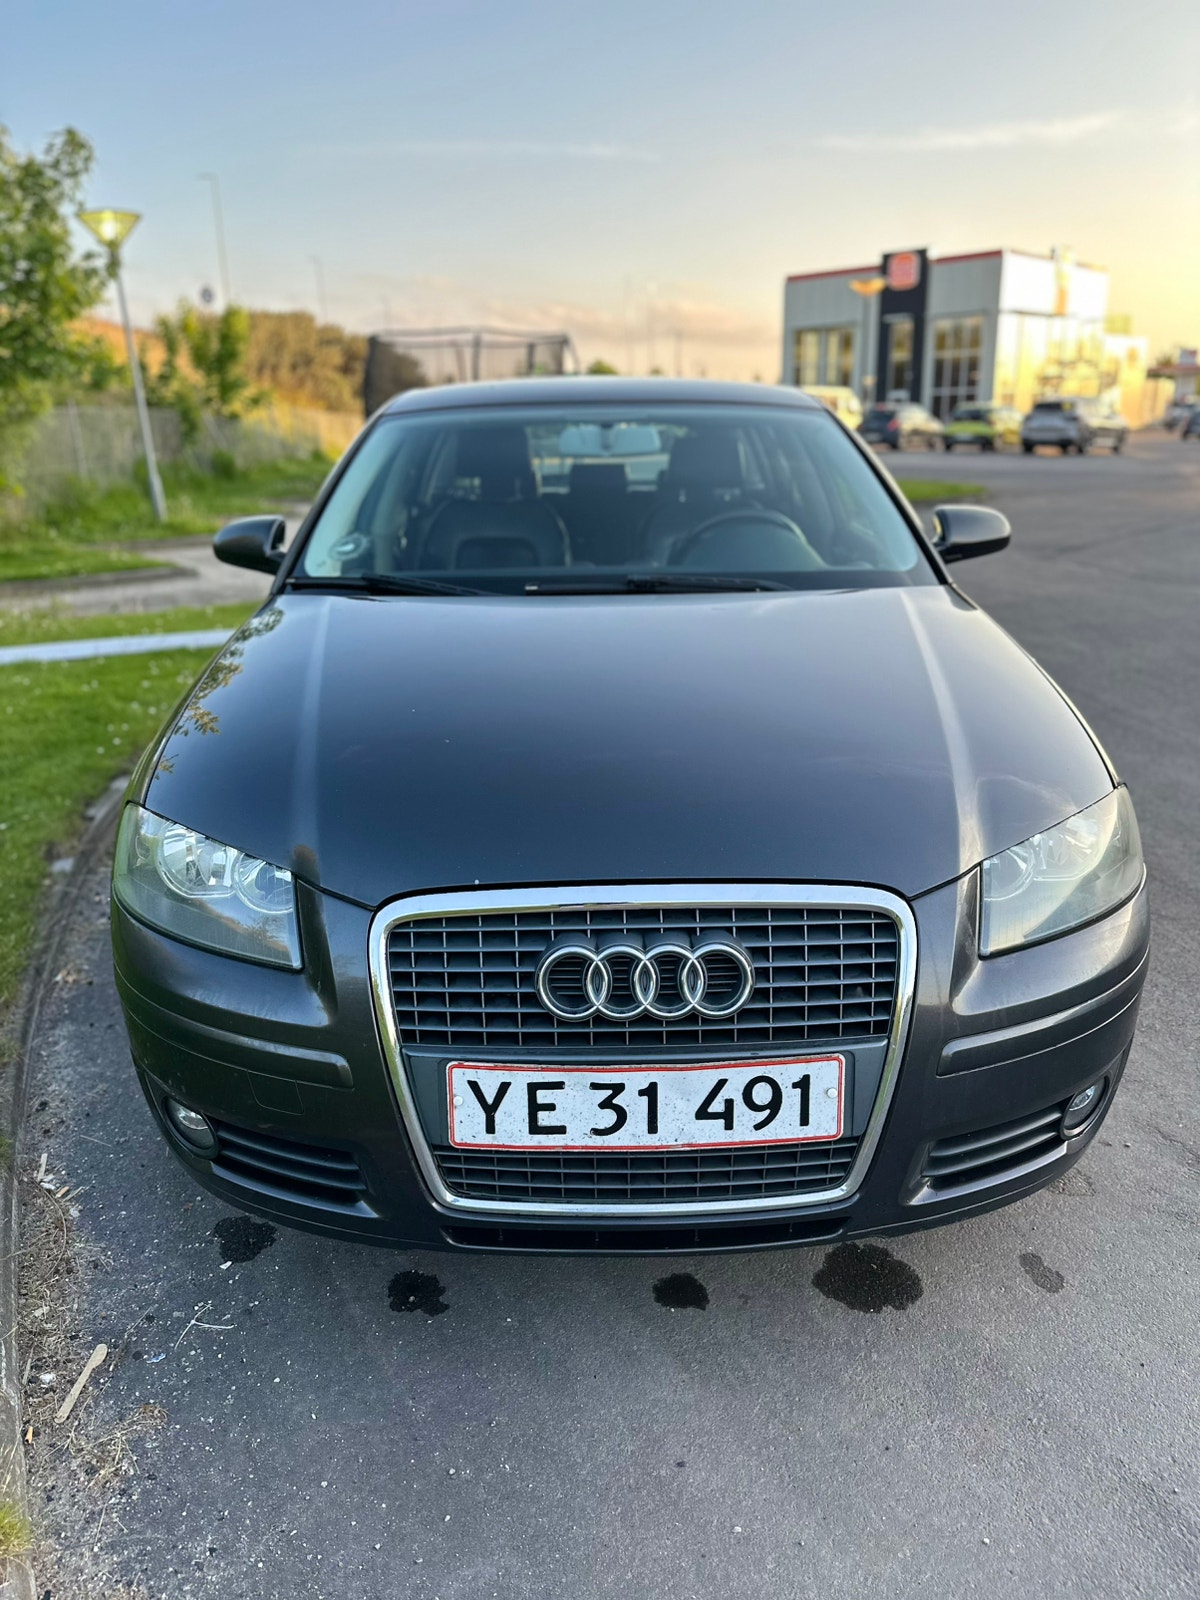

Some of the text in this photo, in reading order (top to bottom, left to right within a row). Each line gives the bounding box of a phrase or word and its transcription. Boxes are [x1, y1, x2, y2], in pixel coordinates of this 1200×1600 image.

[466, 1073, 811, 1137] YE 31 491
